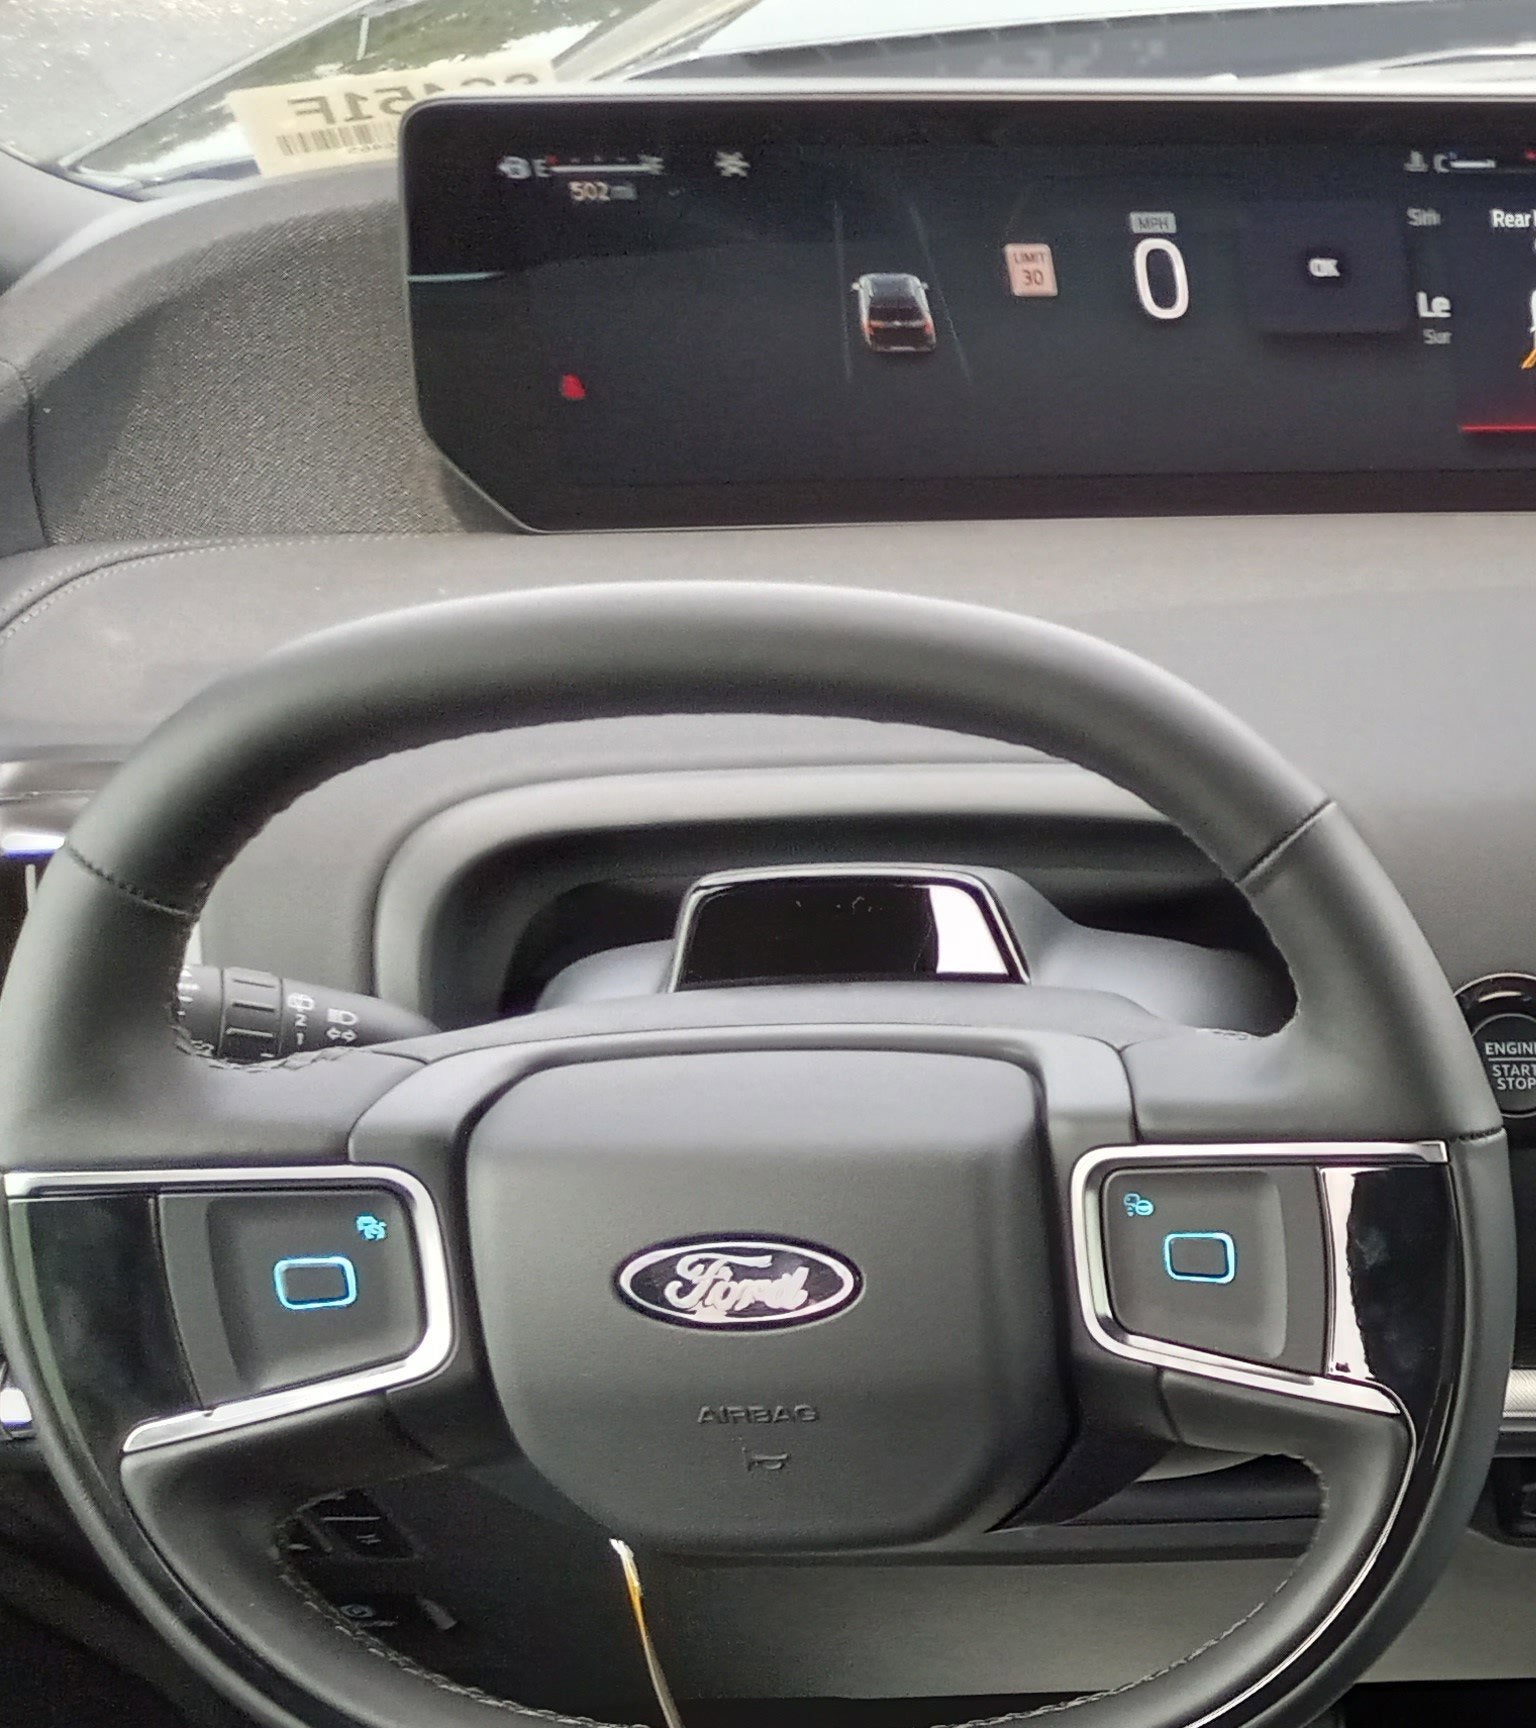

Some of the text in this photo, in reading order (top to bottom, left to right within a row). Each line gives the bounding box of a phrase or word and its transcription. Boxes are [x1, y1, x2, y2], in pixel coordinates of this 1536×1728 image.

[1490, 209, 1530, 228] Rear
[1022, 269, 1043, 287] 30
[663, 1251, 810, 1312] Ford
[697, 1404, 819, 1425] AIRBAG
